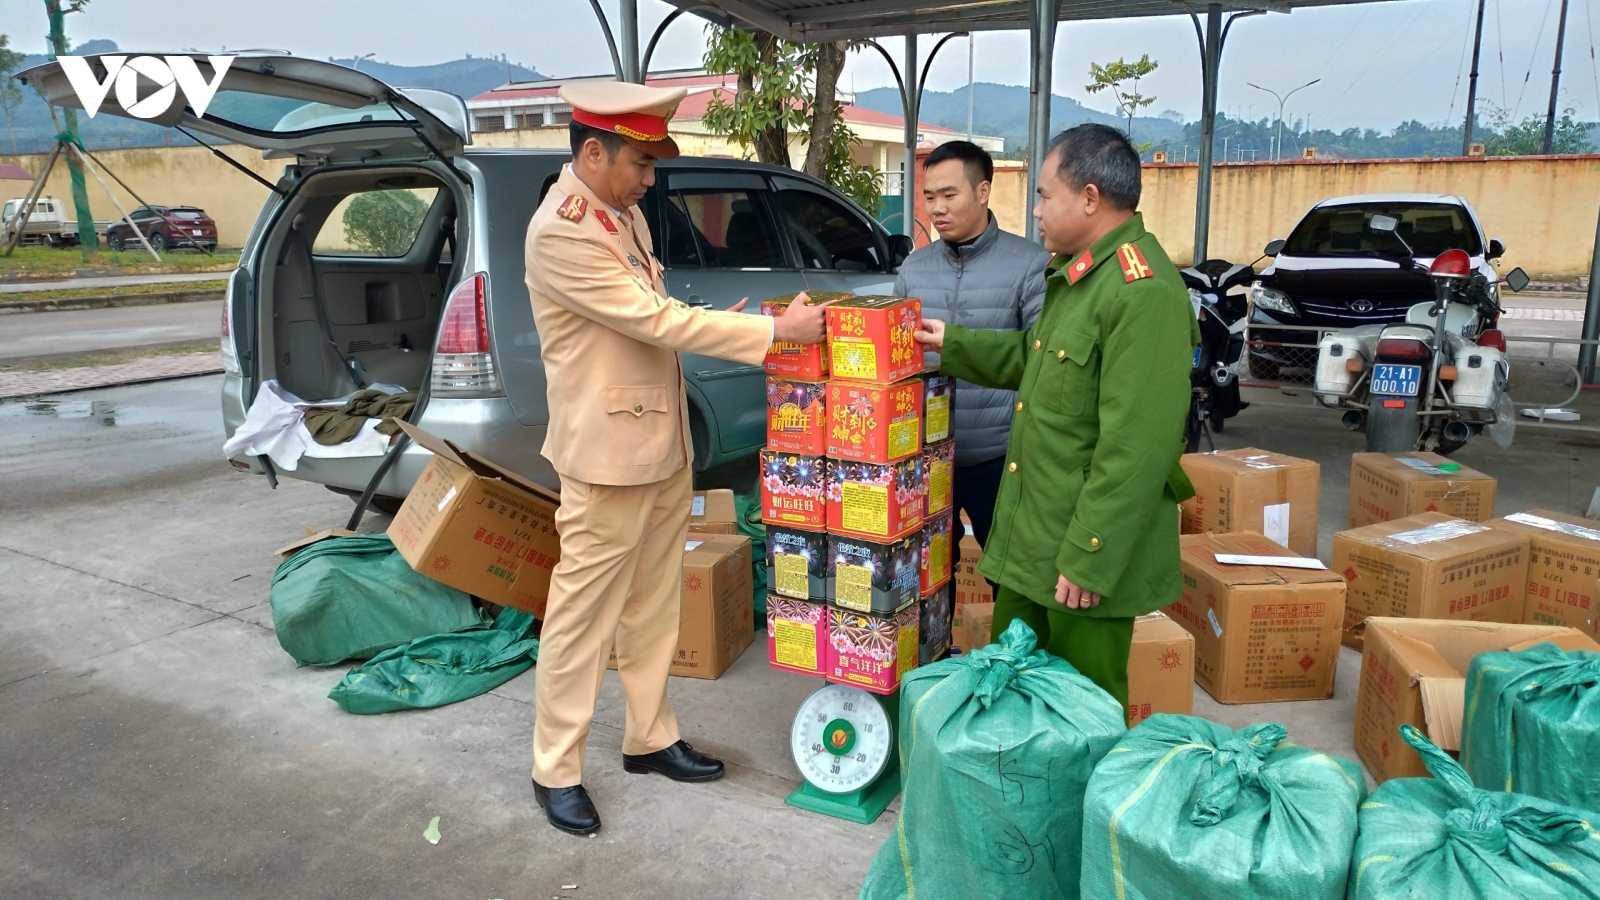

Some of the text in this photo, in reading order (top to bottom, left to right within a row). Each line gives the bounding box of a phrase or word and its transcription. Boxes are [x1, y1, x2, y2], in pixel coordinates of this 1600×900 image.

[1379, 366, 1413, 380] 21-A1
[1373, 379, 1416, 394] 000.10
[772, 495, 815, 512] 财运旺旺
[514, 528, 531, 541] 12/1
[957, 578, 976, 587] 12/1
[1543, 572, 1563, 583] 12/1
[838, 655, 884, 675] 喜气洋洋
[843, 701, 853, 712] 60
[817, 713, 827, 723] 50
[864, 723, 873, 733] 10
[811, 742, 822, 752] 40
[856, 752, 866, 763] 20
[830, 764, 840, 775] 30
